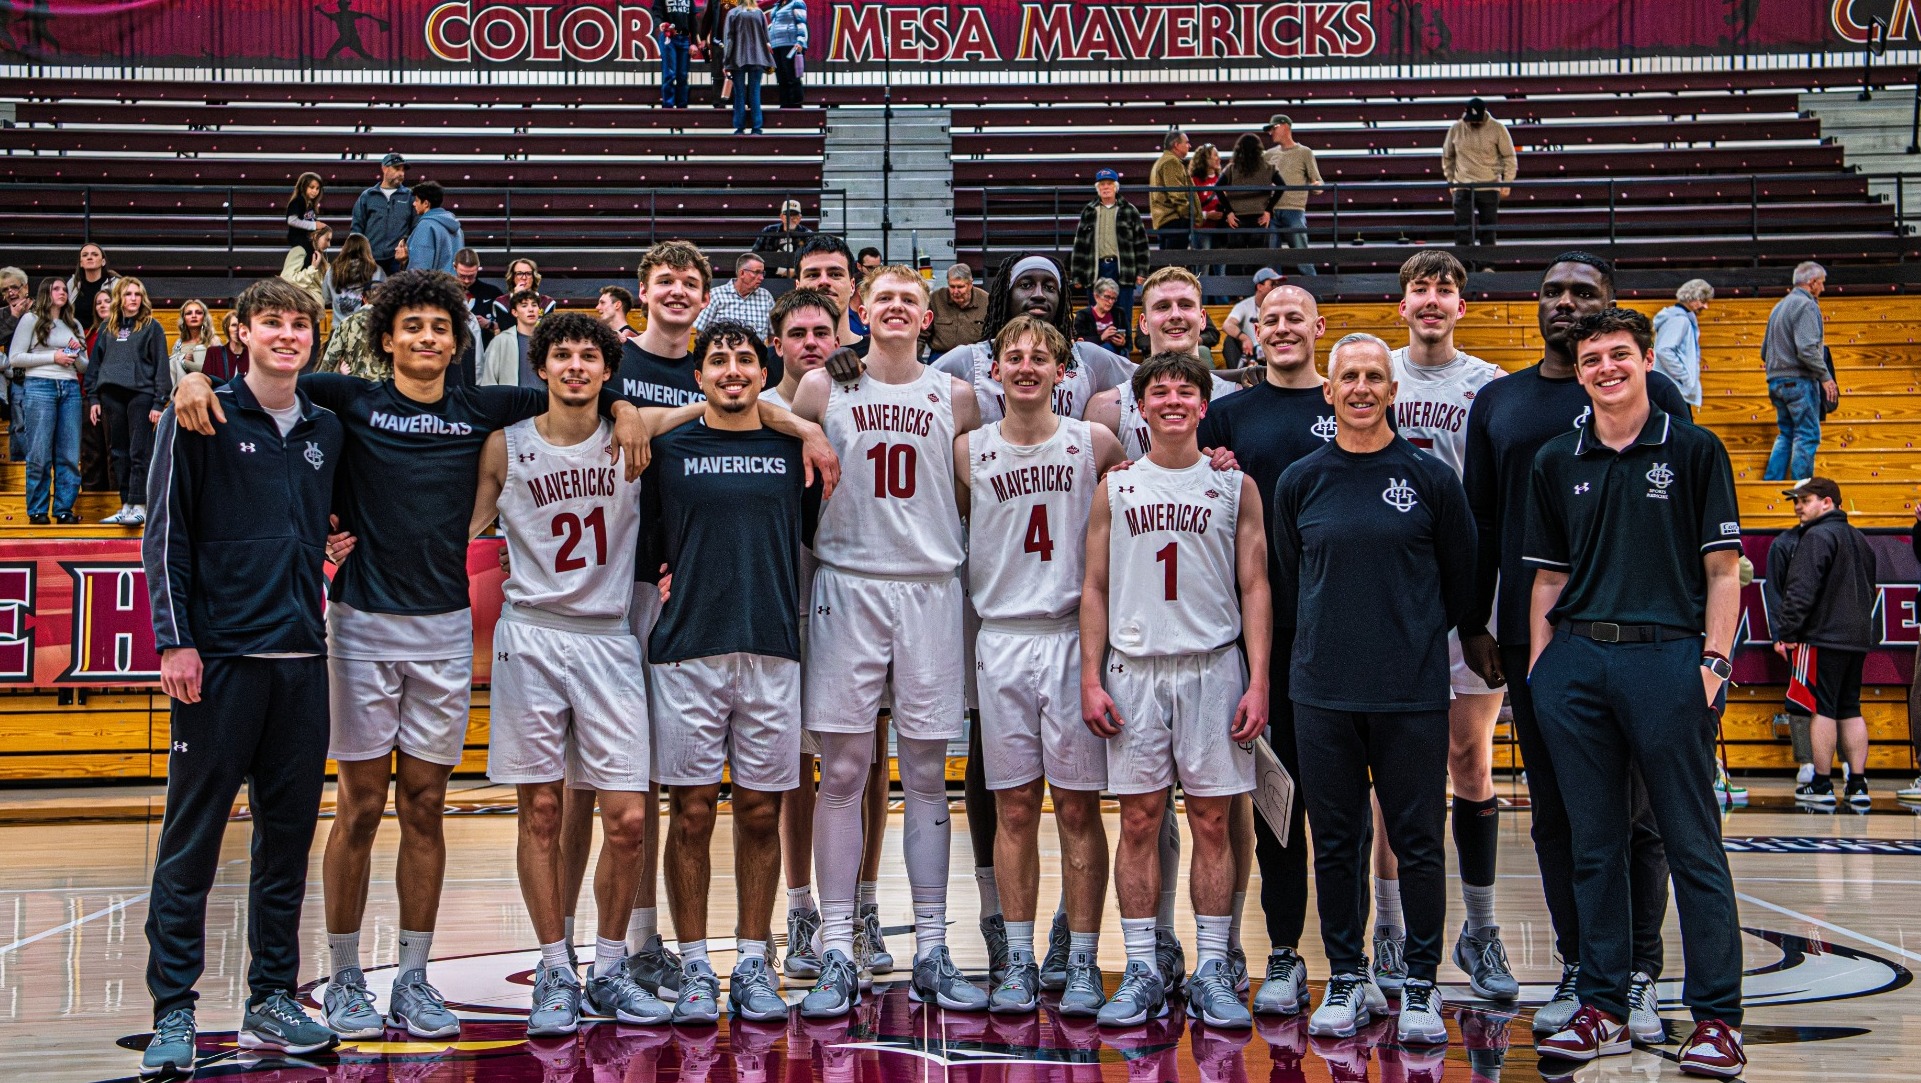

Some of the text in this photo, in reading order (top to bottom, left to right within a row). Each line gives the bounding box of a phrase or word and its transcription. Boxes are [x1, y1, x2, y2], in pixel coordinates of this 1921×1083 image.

[425, 1, 1376, 62] COLOR MESA MAVERICKS
[369, 410, 473, 436] MAVERICKS
[852, 404, 934, 438] MAVERICKS
[1390, 401, 1467, 433] AVERICKS
[684, 456, 787, 476] MAVERICKS
[867, 442, 917, 499] 10
[990, 464, 1074, 503] MAVERICKS
[527, 467, 616, 508] MAVERICKS
[551, 507, 607, 573] 21
[1024, 504, 1054, 562] 4
[1125, 503, 1212, 537] MAVERICKS
[1156, 542, 1178, 601] 1
